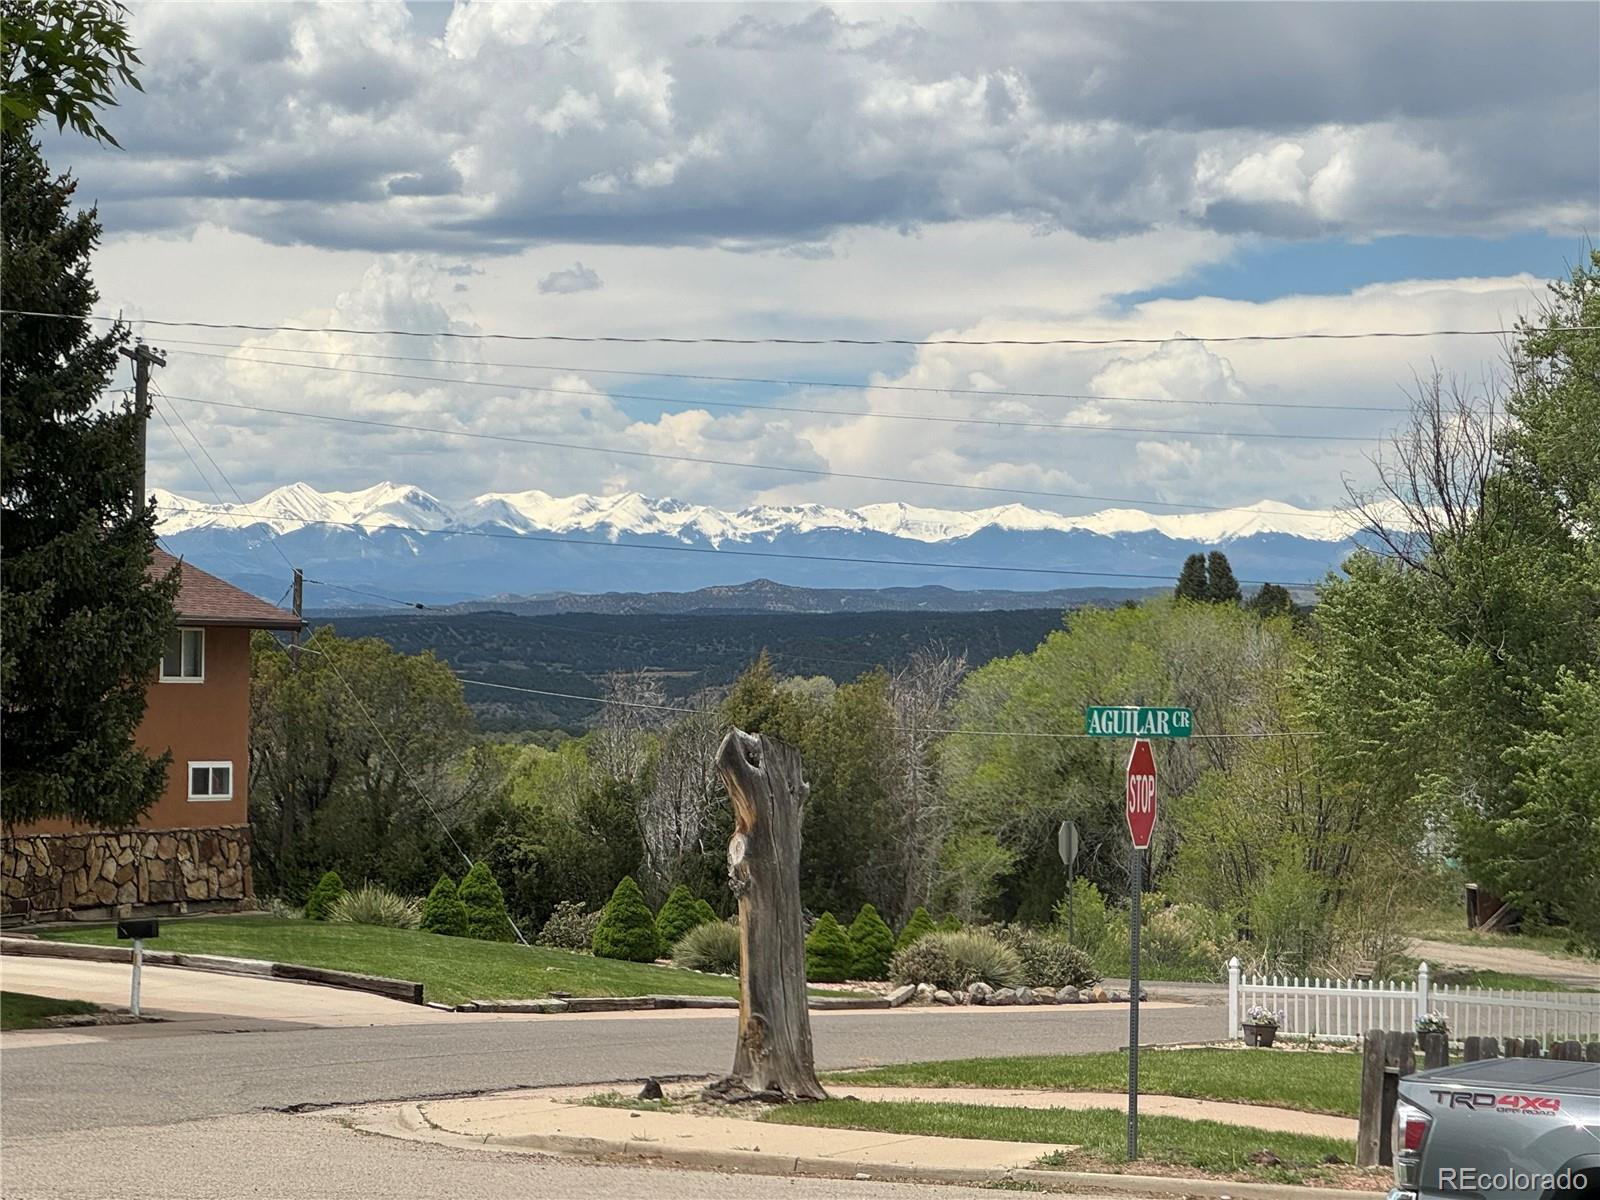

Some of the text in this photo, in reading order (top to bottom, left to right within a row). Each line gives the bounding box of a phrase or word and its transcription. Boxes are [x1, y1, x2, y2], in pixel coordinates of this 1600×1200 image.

[1089, 710, 1190, 734] AGUILAR CR
[1129, 774, 1155, 813] STOP
